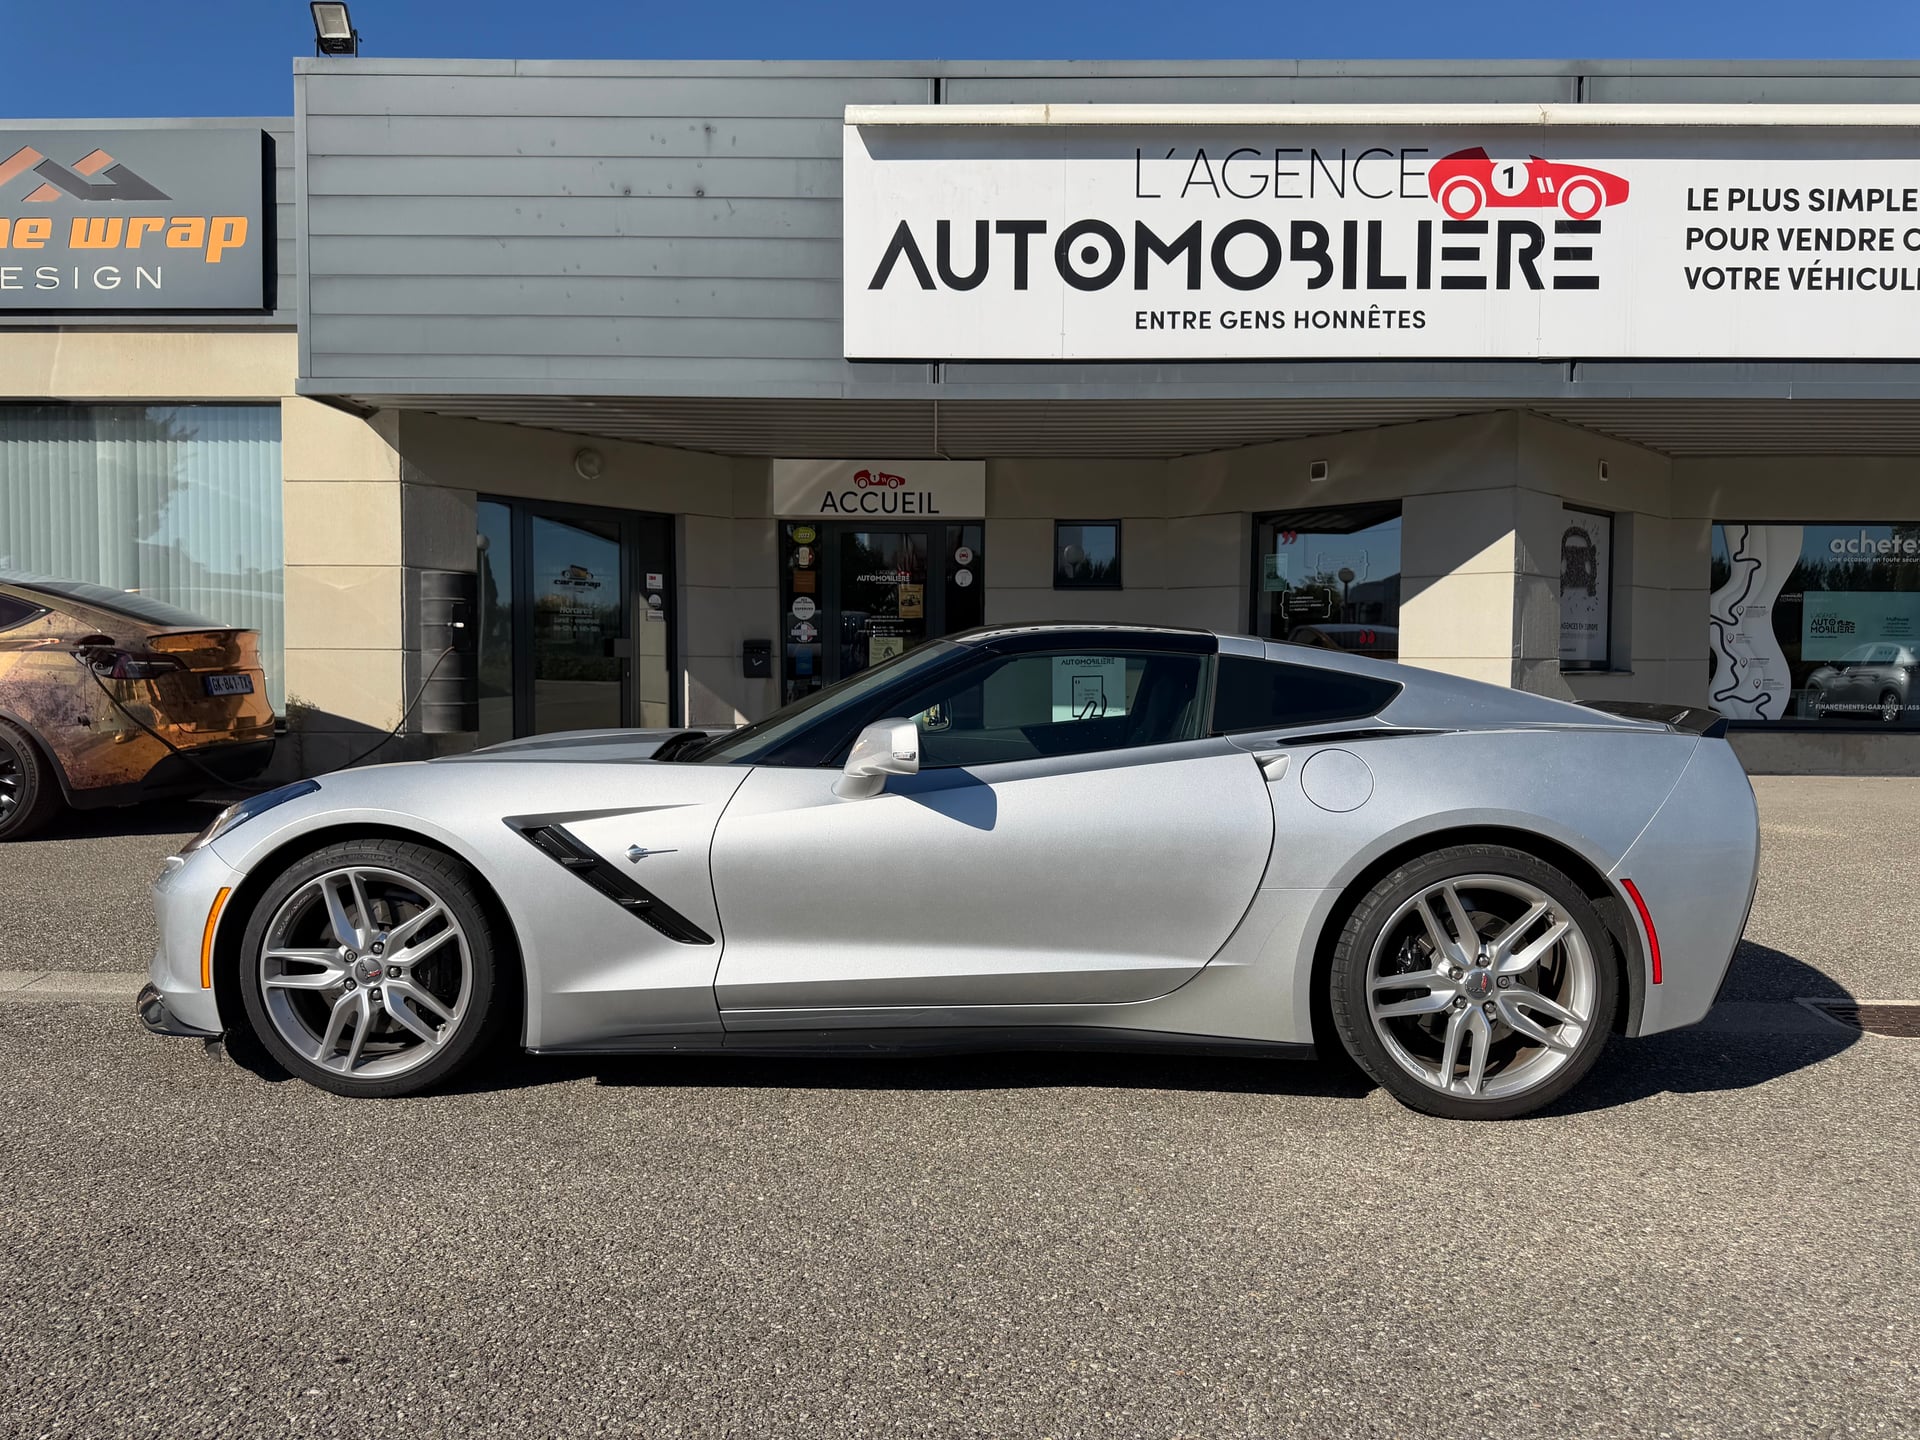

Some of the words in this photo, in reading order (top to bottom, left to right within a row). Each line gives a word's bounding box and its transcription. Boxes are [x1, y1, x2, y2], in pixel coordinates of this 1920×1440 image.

[1501, 165, 1515, 190] 1
[1687, 187, 1719, 211] LE
[1728, 187, 1800, 212] PLUS
[1808, 188, 1918, 212] SIMPLE
[68, 216, 248, 263] wrap
[1686, 227, 1770, 251] POUR
[1777, 228, 1895, 251] VENDRE
[867, 218, 1602, 291] AUTOMOBILIERE
[1684, 266, 1780, 290] VOTRE
[1788, 258, 1920, 291] VÉHICUL
[1136, 311, 1212, 329] ENTRE
[1220, 311, 1286, 329] GENS
[1294, 304, 1426, 329] HONNÊTES
[819, 490, 940, 514] ACCUEIL
[1830, 528, 1920, 554] achete
[1811, 618, 1836, 626] AUTO
